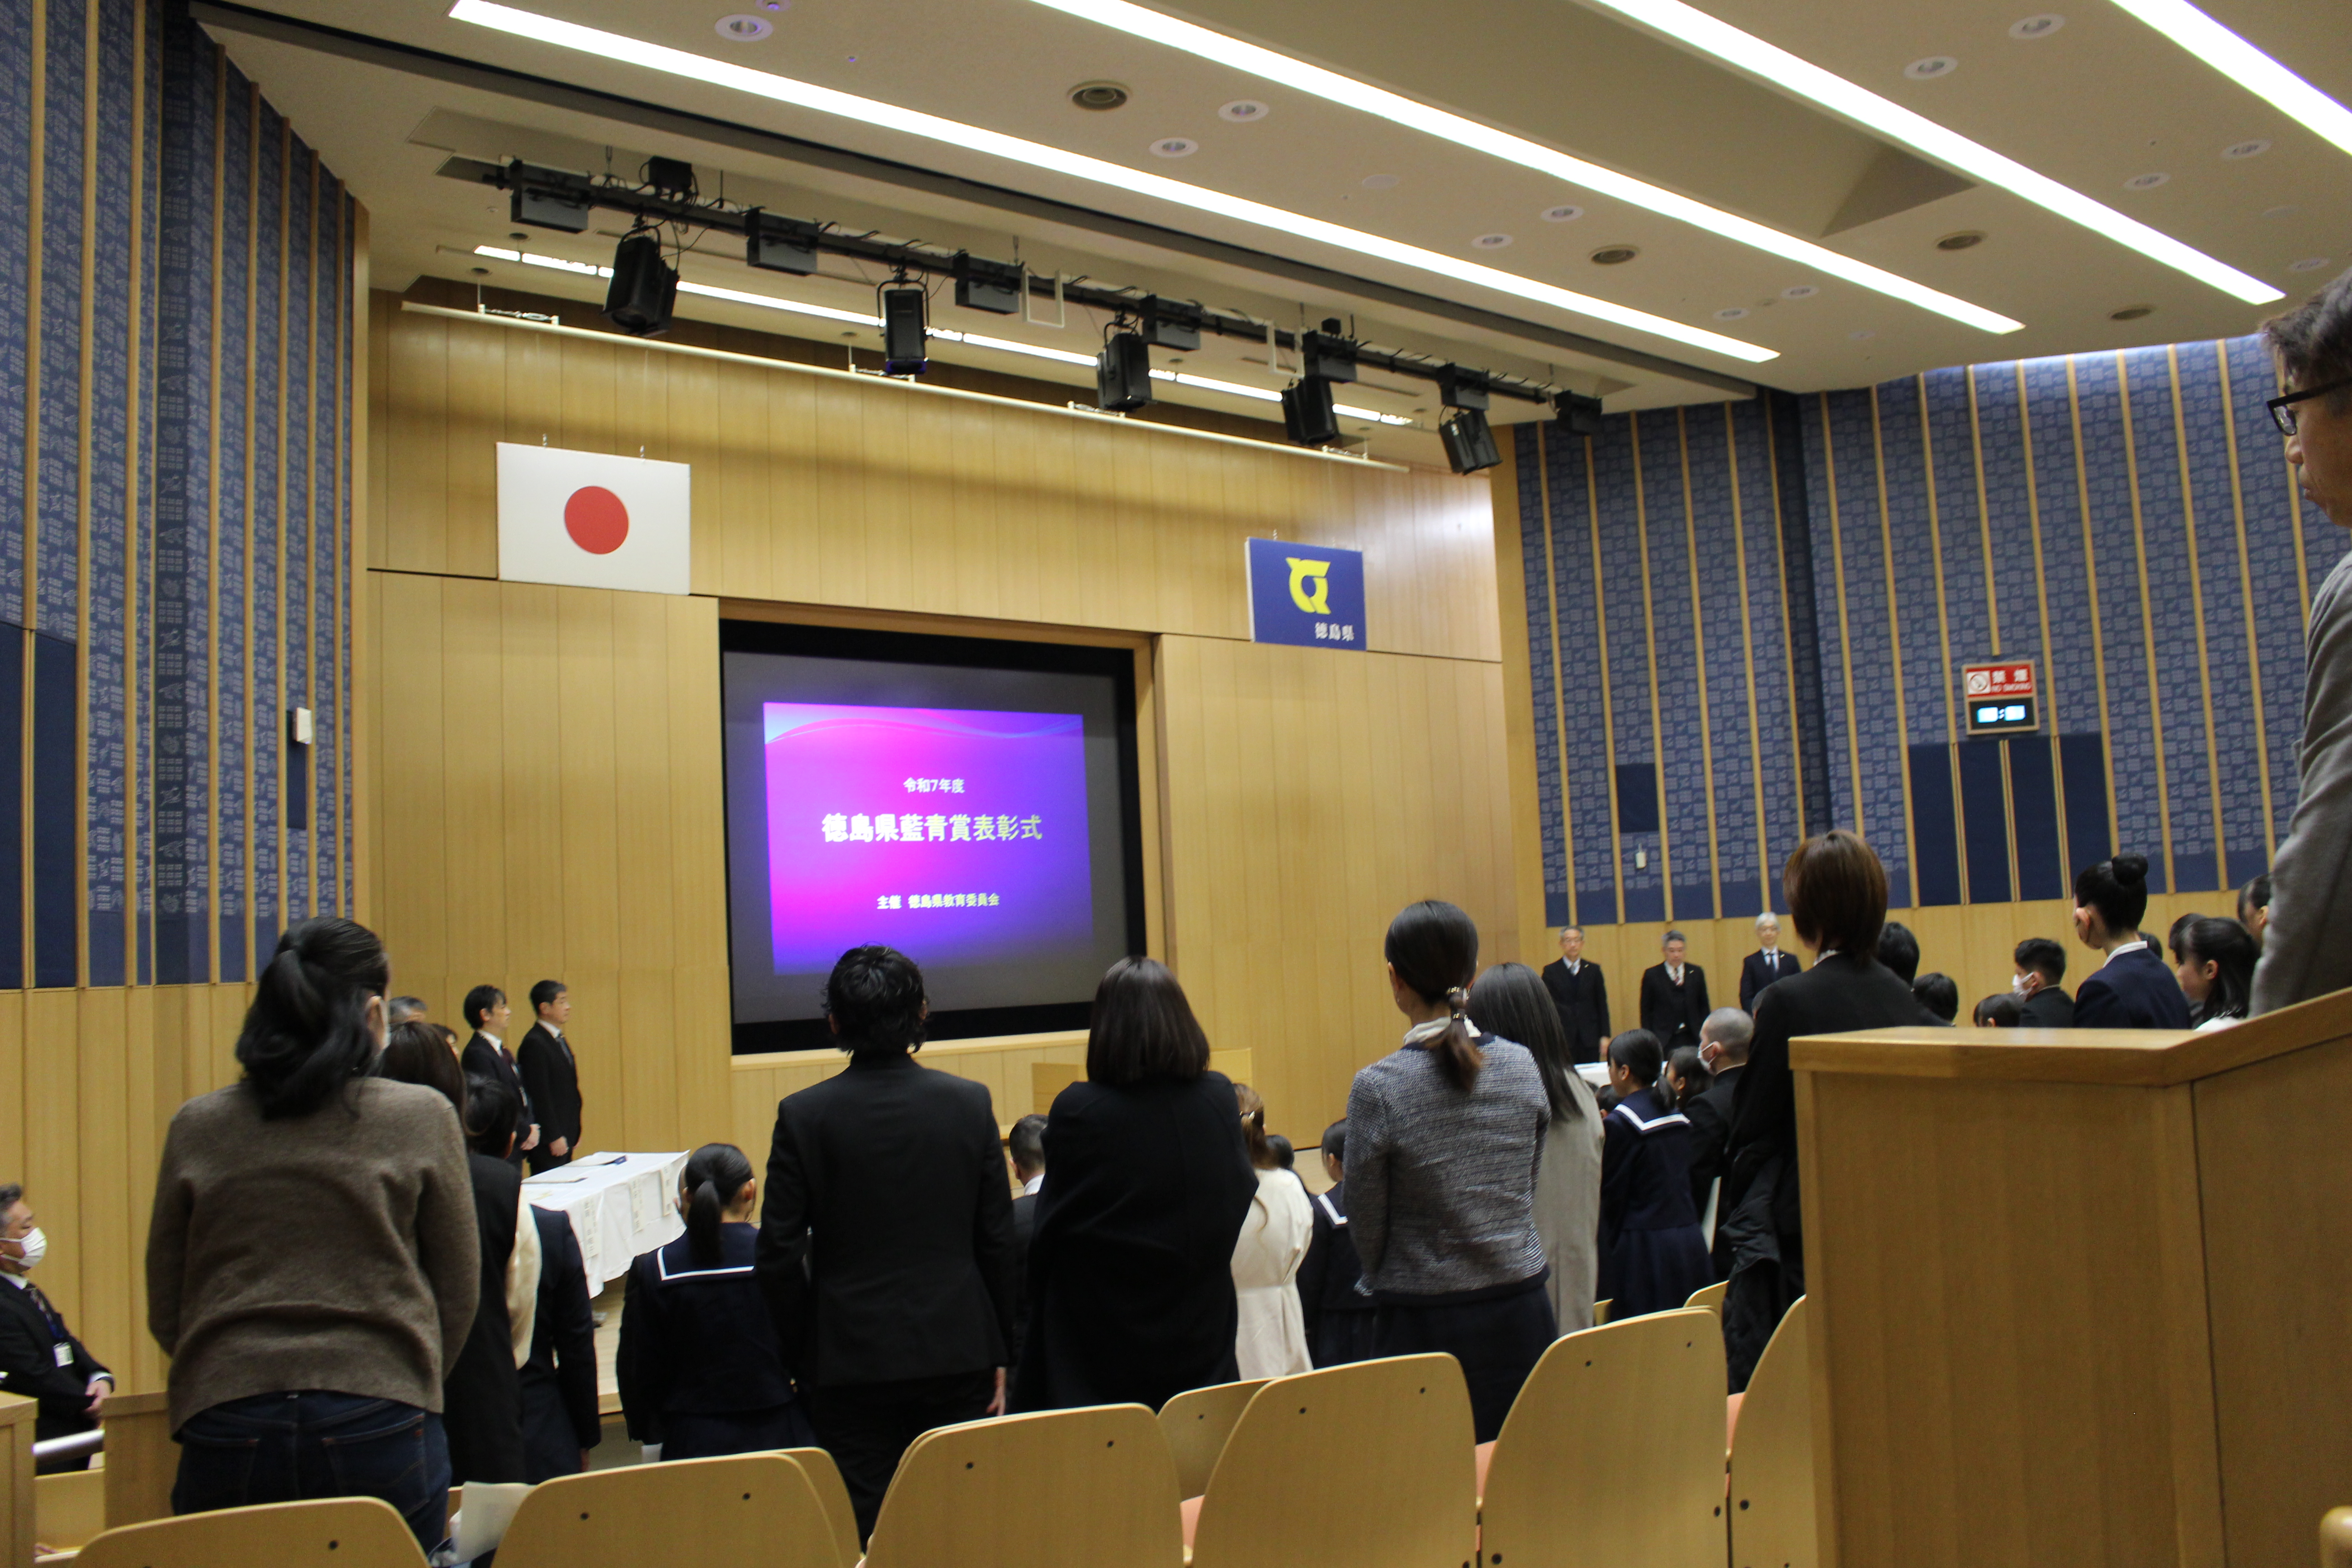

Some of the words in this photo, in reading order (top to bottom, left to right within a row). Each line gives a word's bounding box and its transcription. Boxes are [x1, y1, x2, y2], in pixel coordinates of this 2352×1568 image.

[1314, 622, 1354, 642] 徳島県
[903, 777, 965, 794] 令和7年度
[822, 813, 1043, 843] 徳島県藍青賞表彰式
[908, 892, 1000, 908] 徳島県教育委員会
